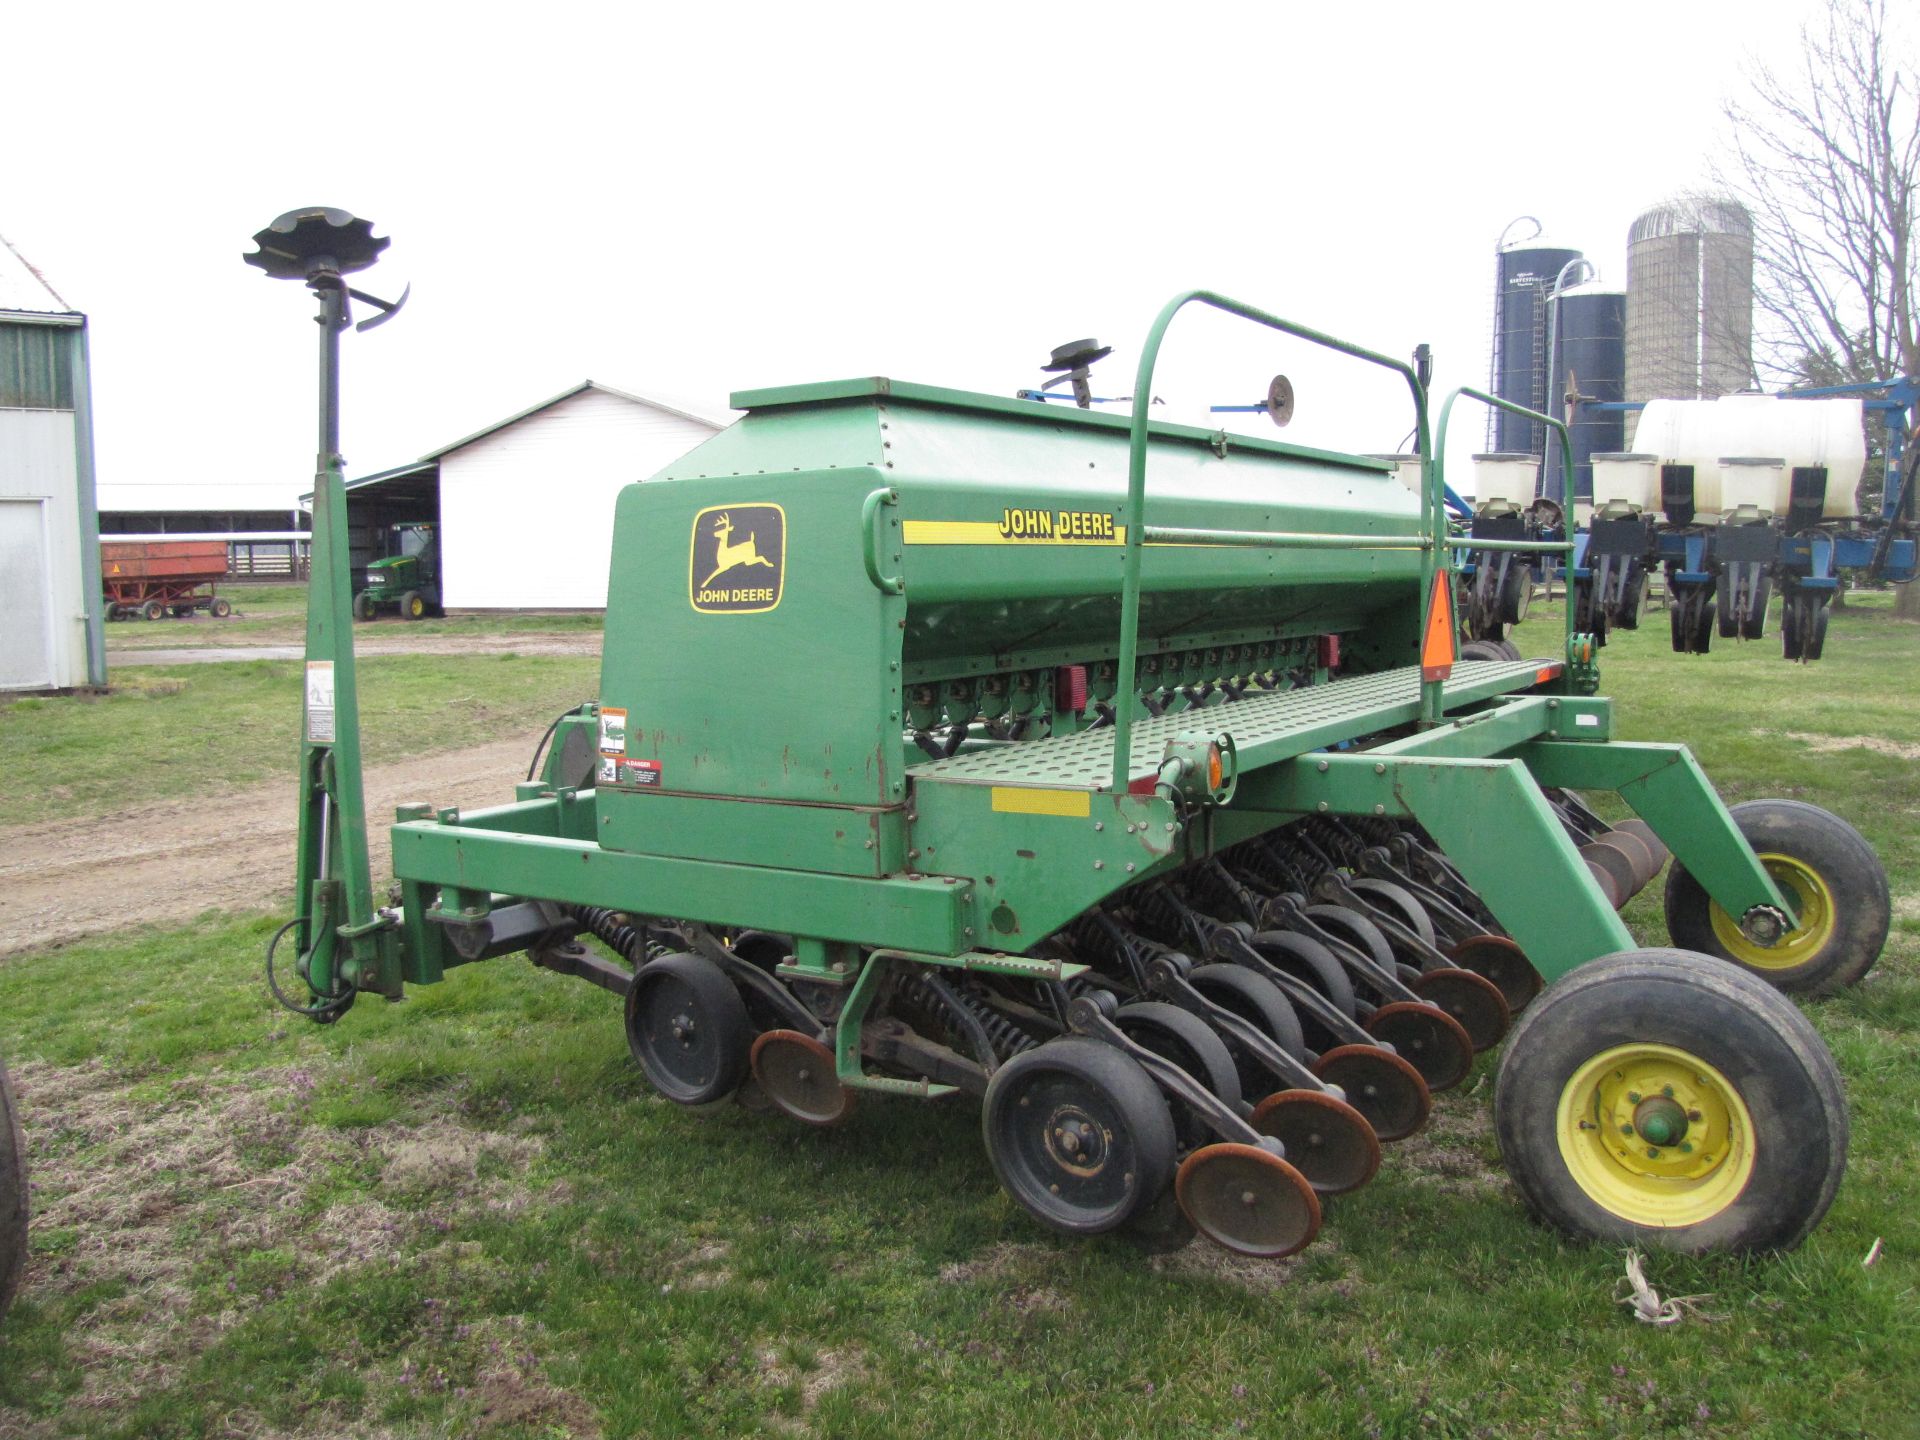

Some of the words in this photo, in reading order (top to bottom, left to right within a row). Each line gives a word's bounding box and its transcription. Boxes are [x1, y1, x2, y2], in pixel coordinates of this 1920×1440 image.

[999, 508, 1053, 537] JOHN
[1058, 511, 1114, 538] DEERE
[697, 590, 730, 603] JOHN
[732, 588, 774, 602] DEERE
[630, 760, 651, 768] DANGER
